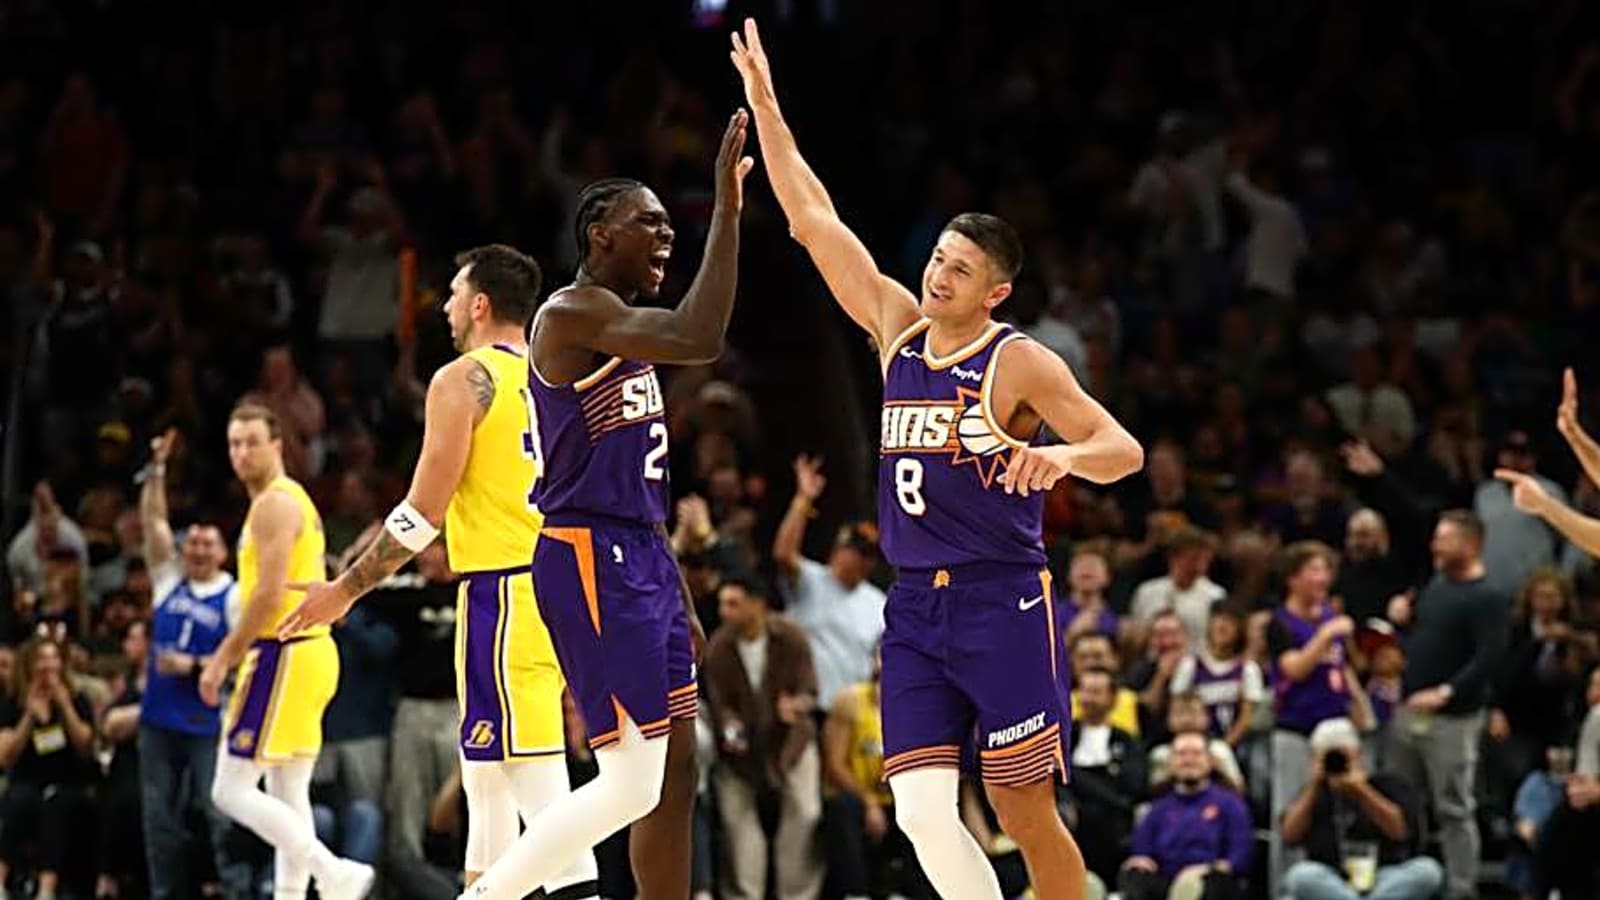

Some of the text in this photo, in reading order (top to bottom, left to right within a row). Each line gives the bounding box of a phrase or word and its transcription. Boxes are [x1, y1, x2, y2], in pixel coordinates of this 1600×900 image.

[951, 365, 984, 382] PayPal
[622, 370, 664, 420] SU
[881, 406, 958, 448] UNS
[644, 422, 670, 480] 2
[895, 458, 926, 516] 8
[393, 512, 416, 533] 77
[988, 711, 1046, 748] PHOENIX
